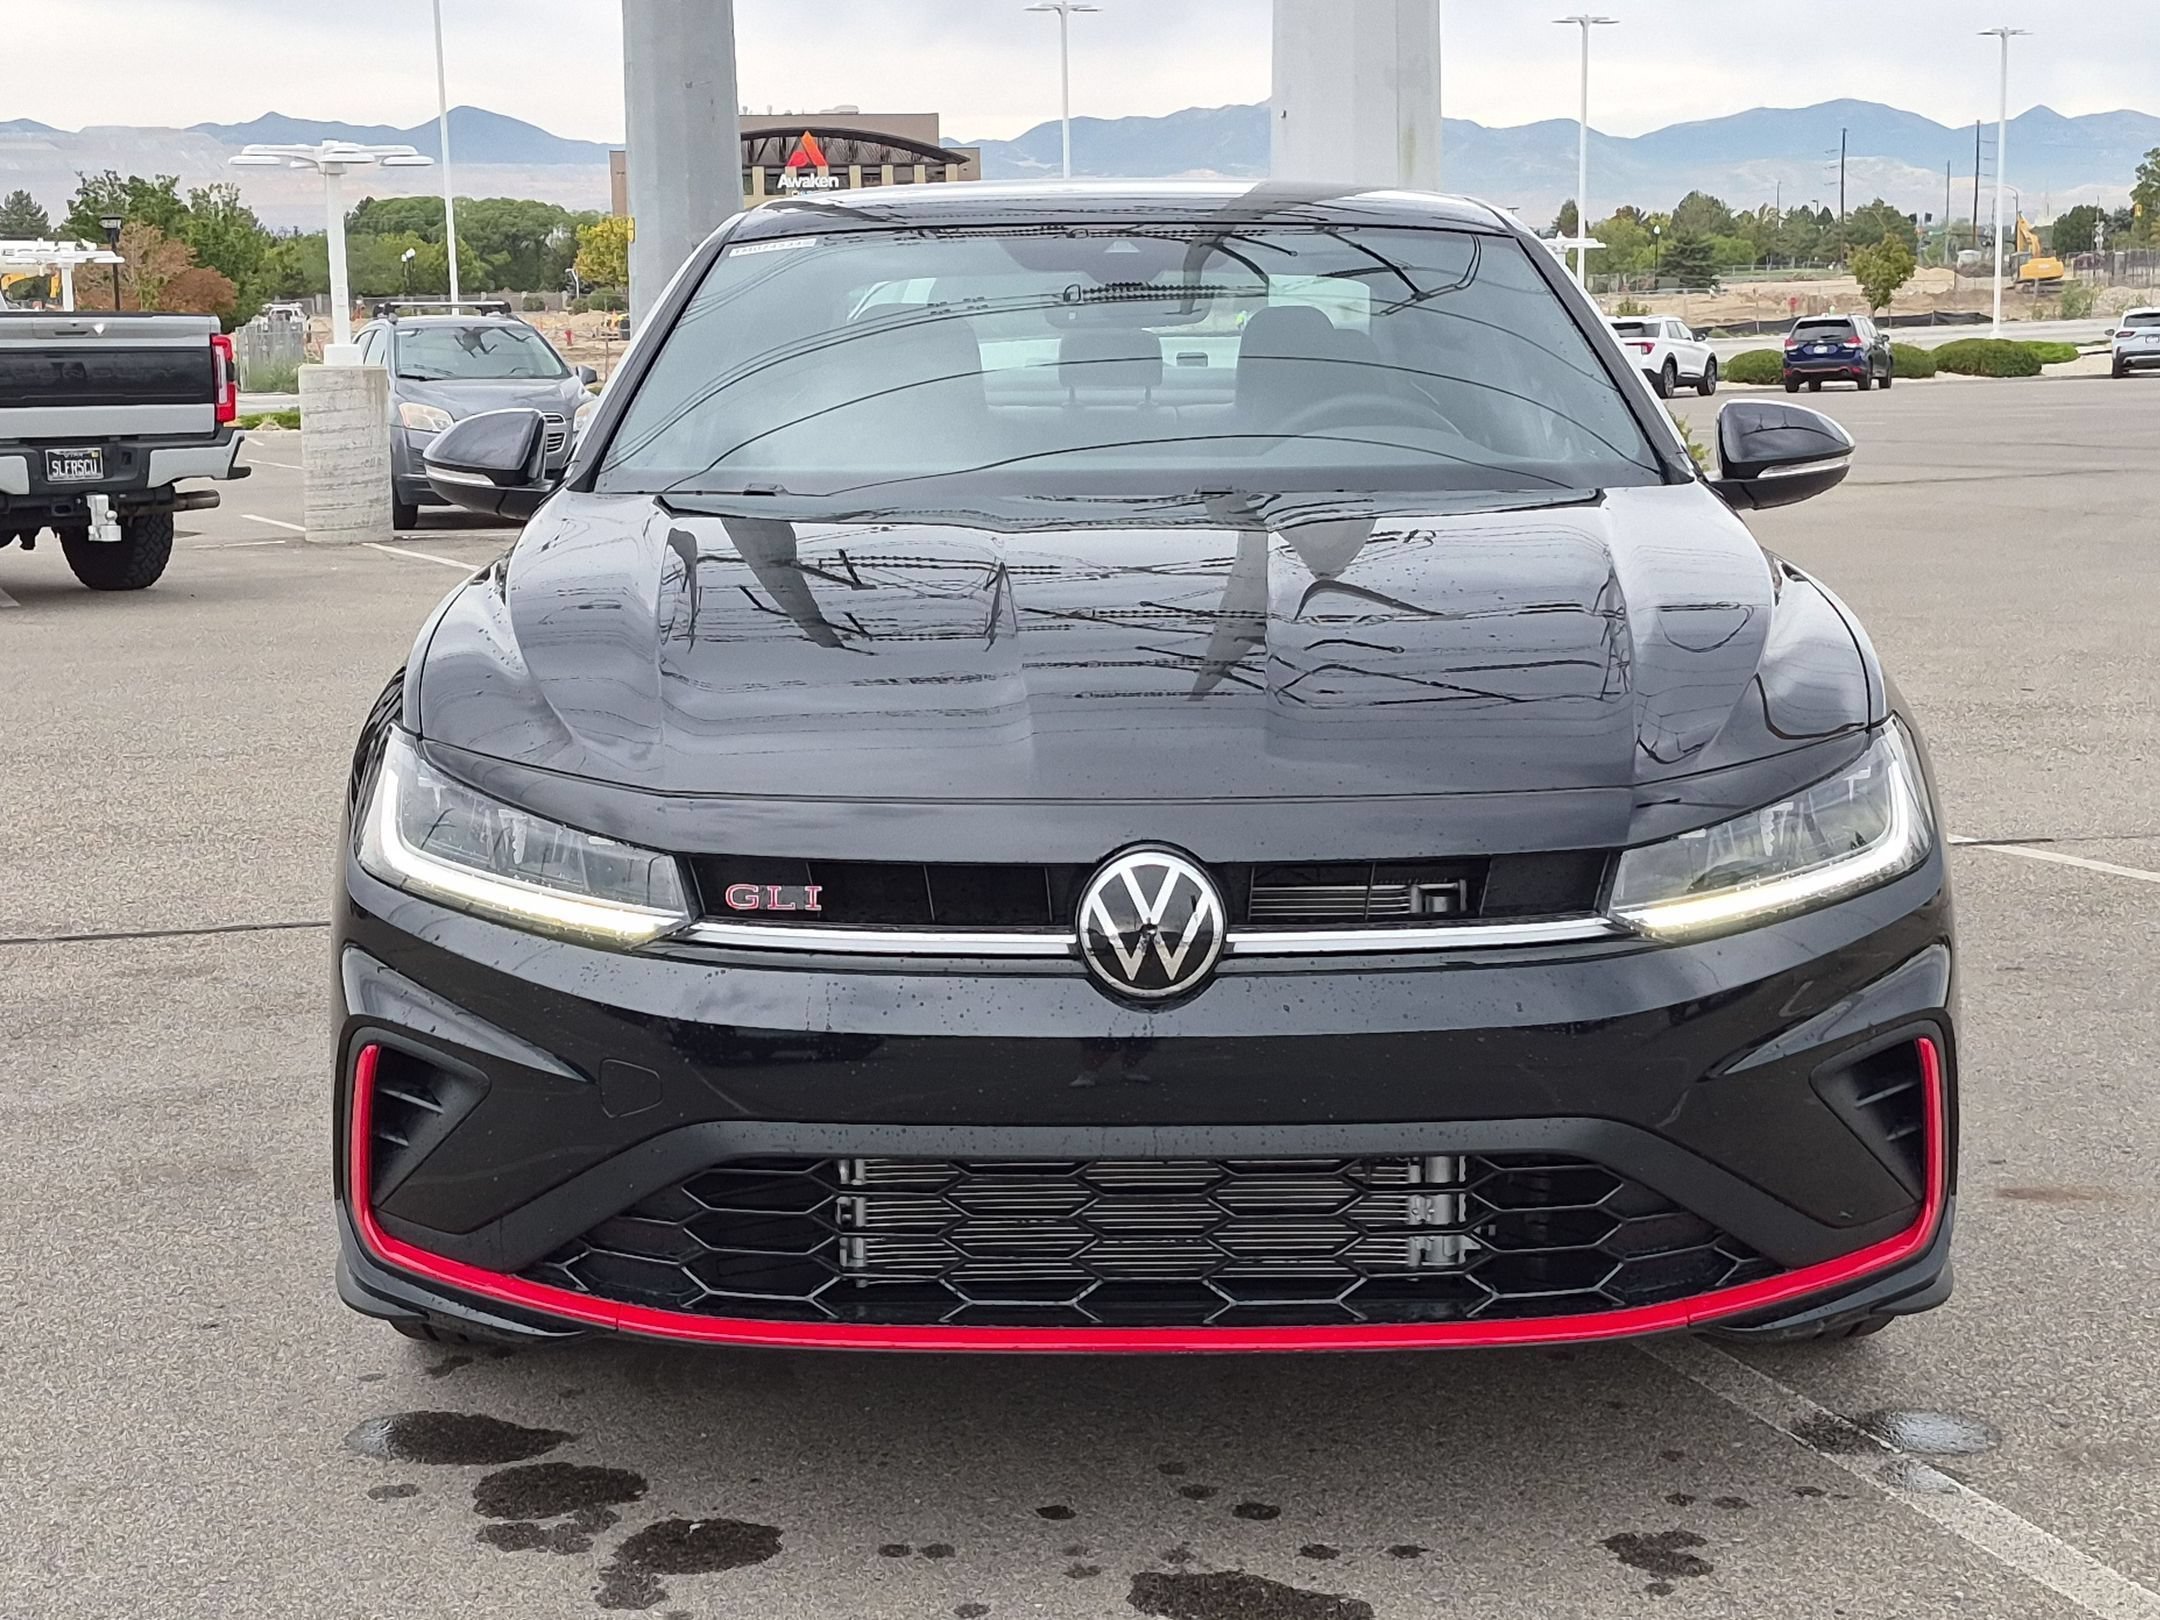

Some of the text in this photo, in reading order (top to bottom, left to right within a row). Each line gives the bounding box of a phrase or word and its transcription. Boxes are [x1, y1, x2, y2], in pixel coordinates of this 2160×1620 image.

[777, 172, 839, 189] Awaken
[52, 459, 97, 476] SLFRSCU
[725, 883, 822, 911] GLI
